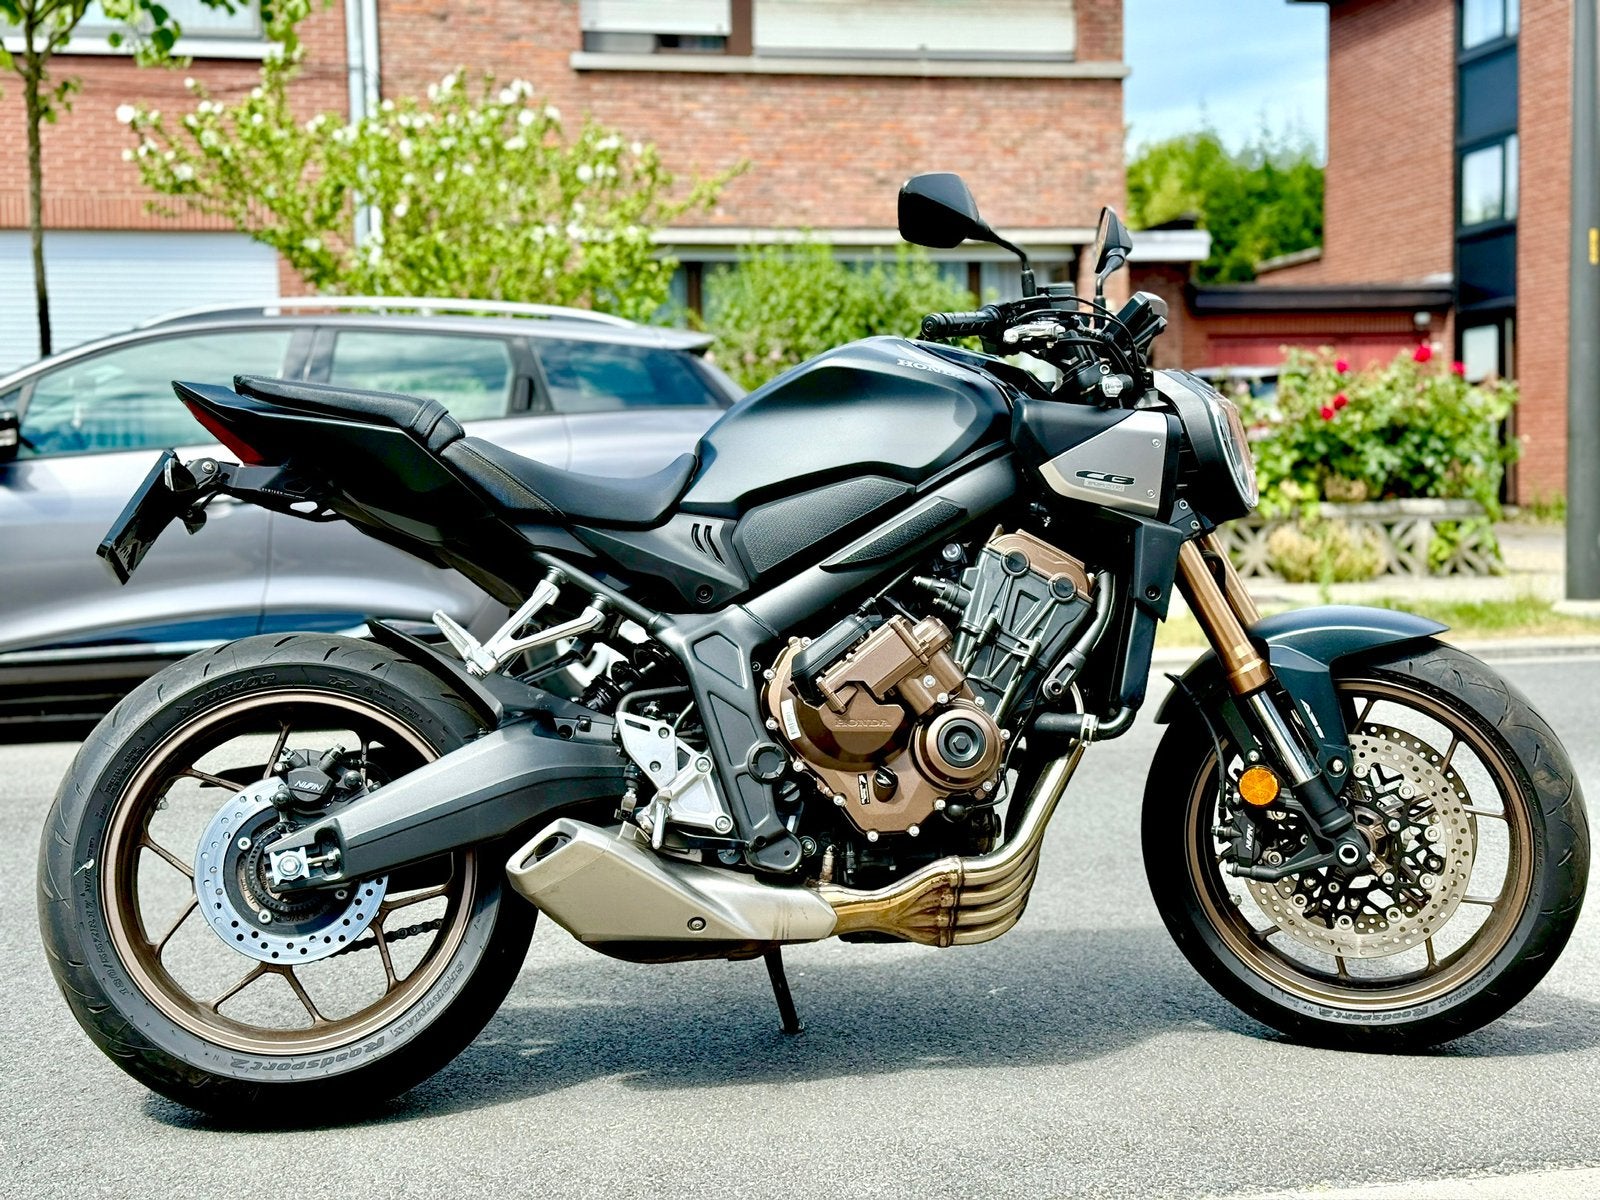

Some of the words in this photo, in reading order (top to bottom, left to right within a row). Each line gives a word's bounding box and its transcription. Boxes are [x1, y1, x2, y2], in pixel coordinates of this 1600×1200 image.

[1075, 470, 1136, 486] CB
[834, 718, 892, 728] HONDA
[392, 960, 464, 1038] SPORTMAX
